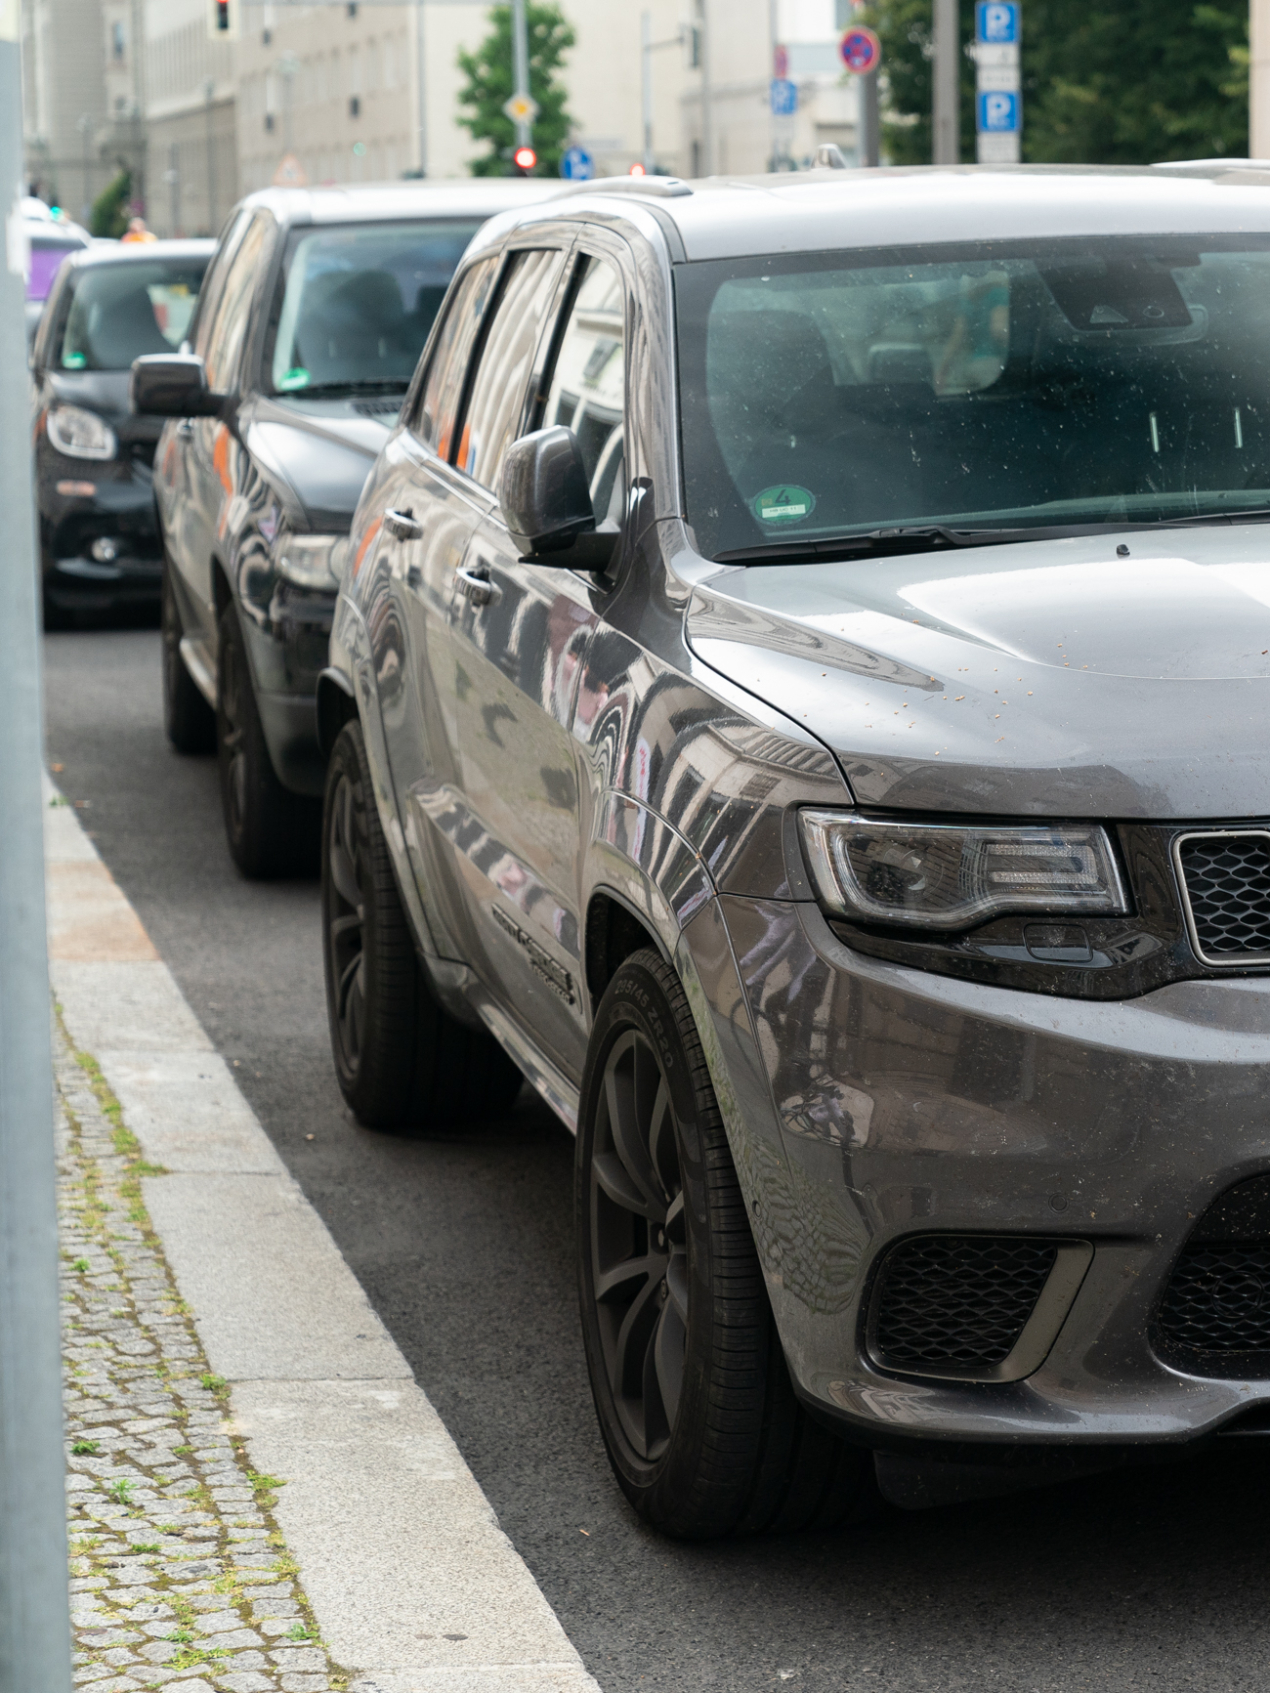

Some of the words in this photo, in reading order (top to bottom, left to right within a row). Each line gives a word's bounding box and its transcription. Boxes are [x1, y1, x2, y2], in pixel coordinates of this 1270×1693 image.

[774, 488, 791, 505] 4
[614, 979, 650, 1008] 295/45
[647, 1006, 673, 1068] ZR20
